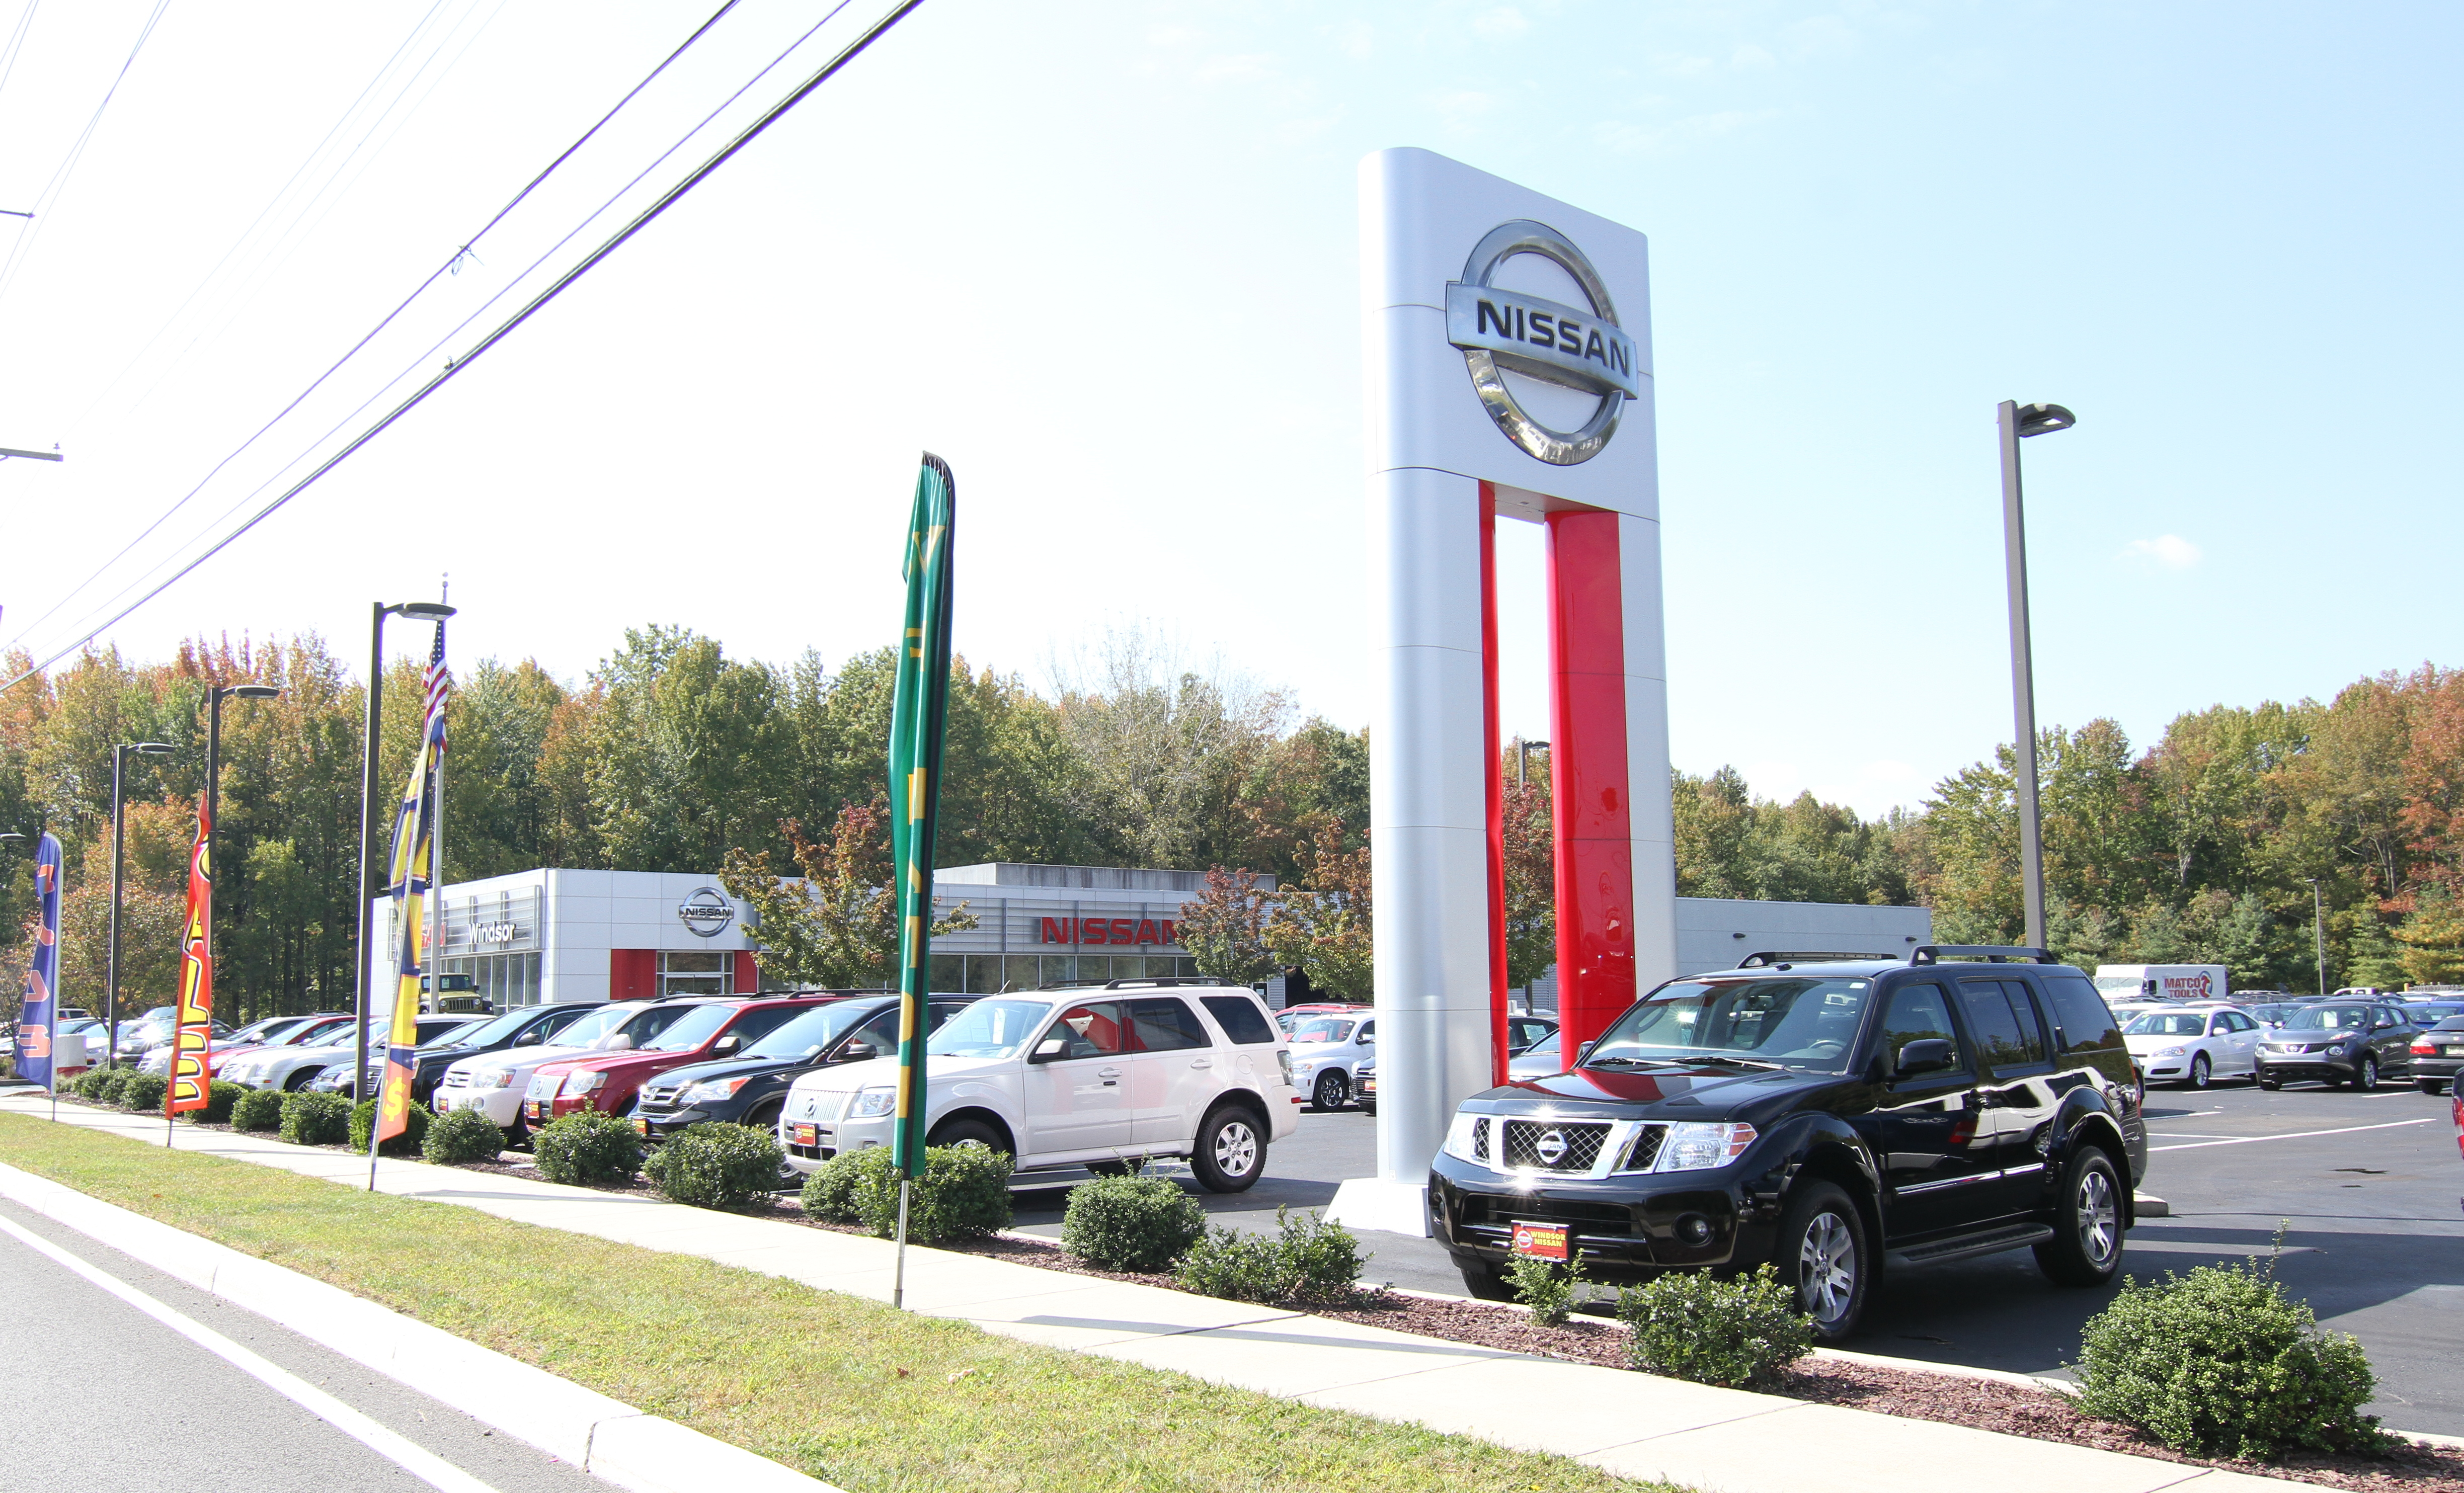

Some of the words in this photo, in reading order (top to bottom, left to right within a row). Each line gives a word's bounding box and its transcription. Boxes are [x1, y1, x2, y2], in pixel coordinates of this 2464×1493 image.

[1476, 299, 1630, 378] NISSAN
[686, 908, 730, 916] NISSAN
[468, 921, 516, 944] Windsor
[1041, 917, 1186, 945] NISSAN
[2165, 977, 2200, 988] MATCO
[2168, 989, 2198, 998] TOOLS
[1530, 1231, 1566, 1240] WINDSOR
[1534, 1238, 1562, 1247] NISSAN
